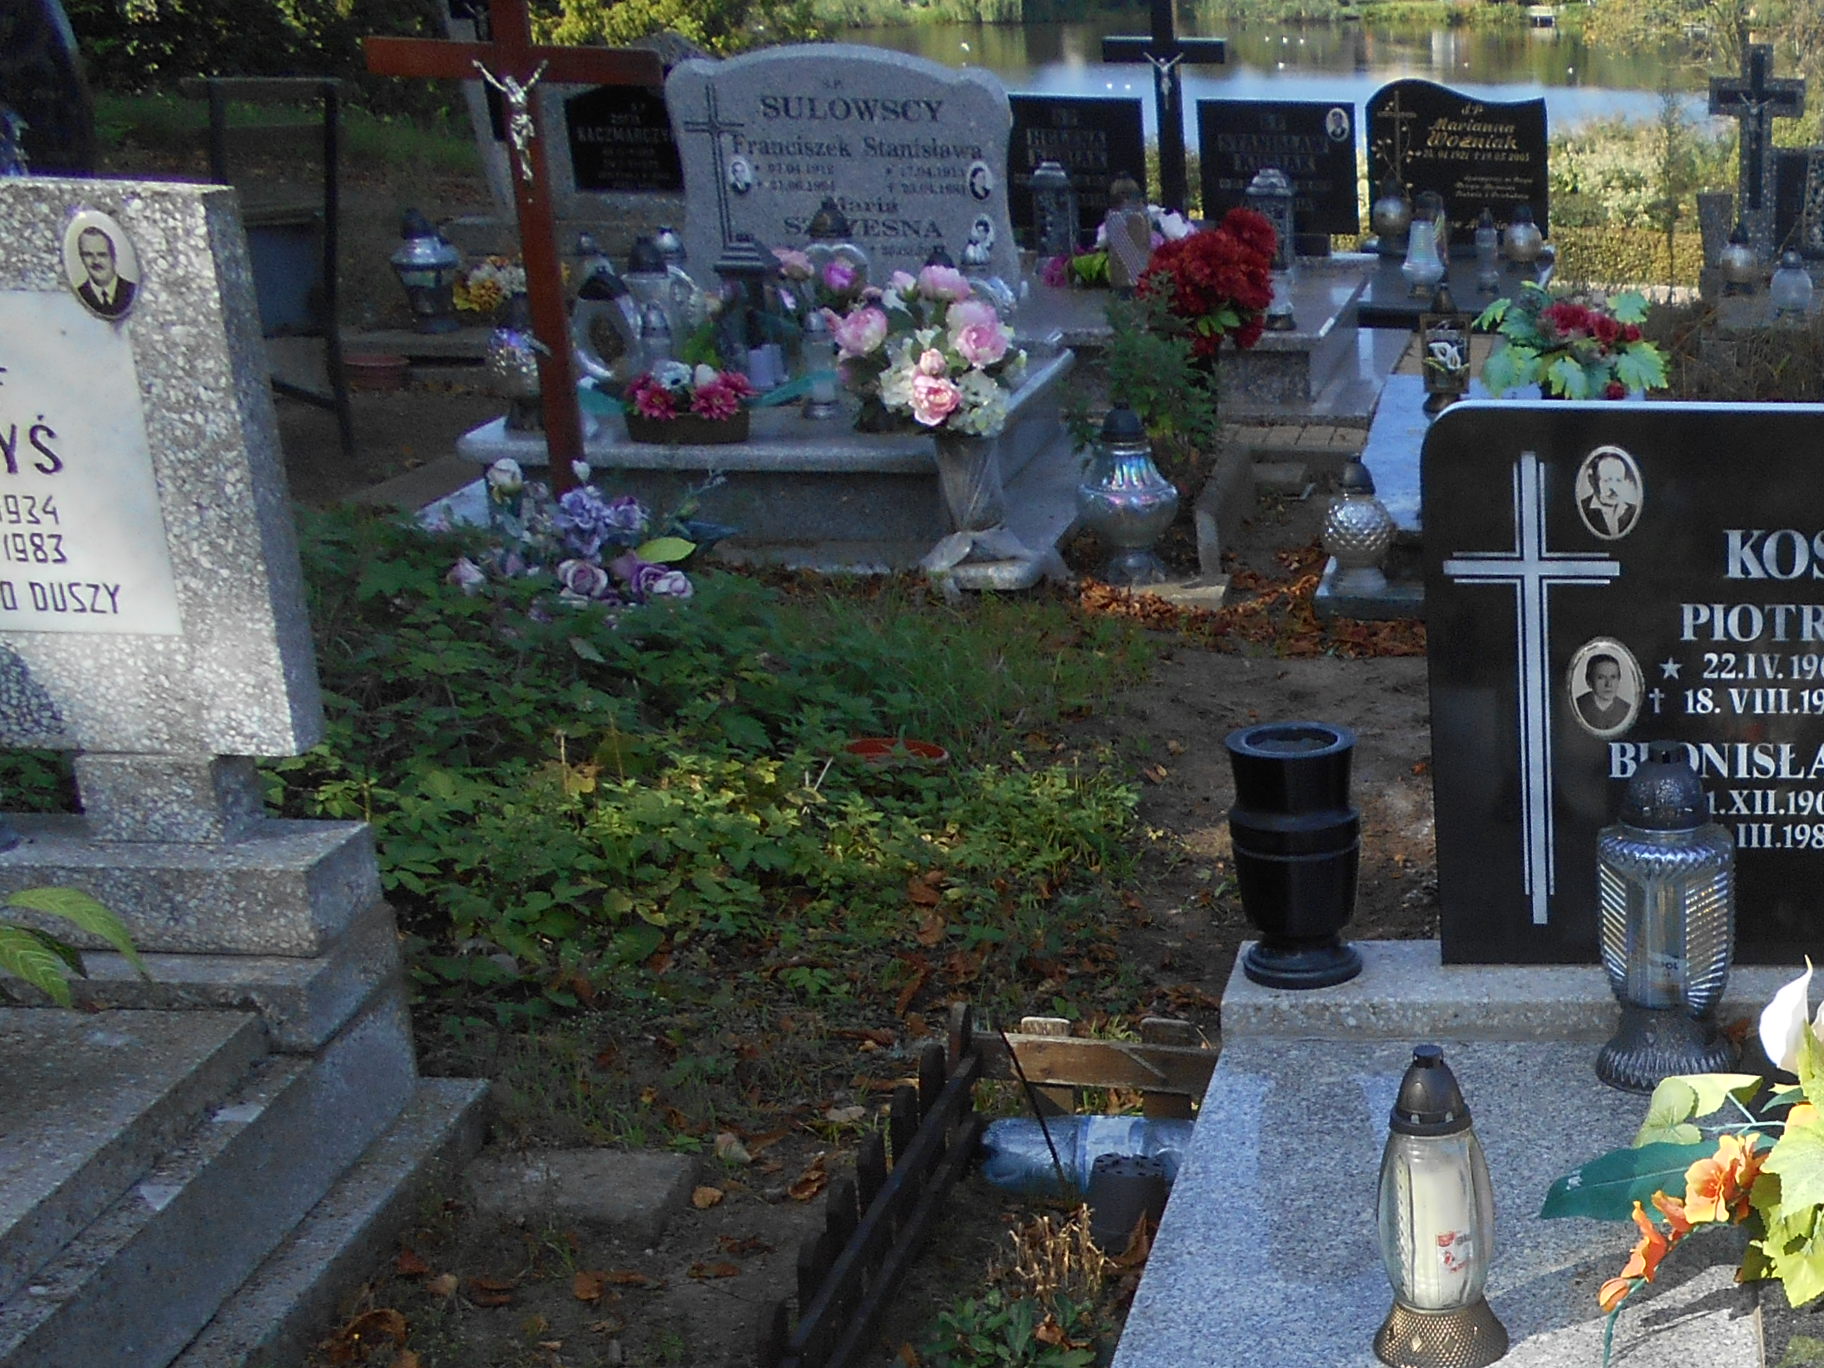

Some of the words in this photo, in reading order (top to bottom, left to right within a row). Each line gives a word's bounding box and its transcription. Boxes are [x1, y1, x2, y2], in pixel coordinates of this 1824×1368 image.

[1428, 117, 1516, 133] Marianna
[732, 133, 851, 158] Franciszek
[0, 495, 60, 525] 934
[3, 533, 68, 563] 1983
[29, 581, 120, 613] DUSZY
